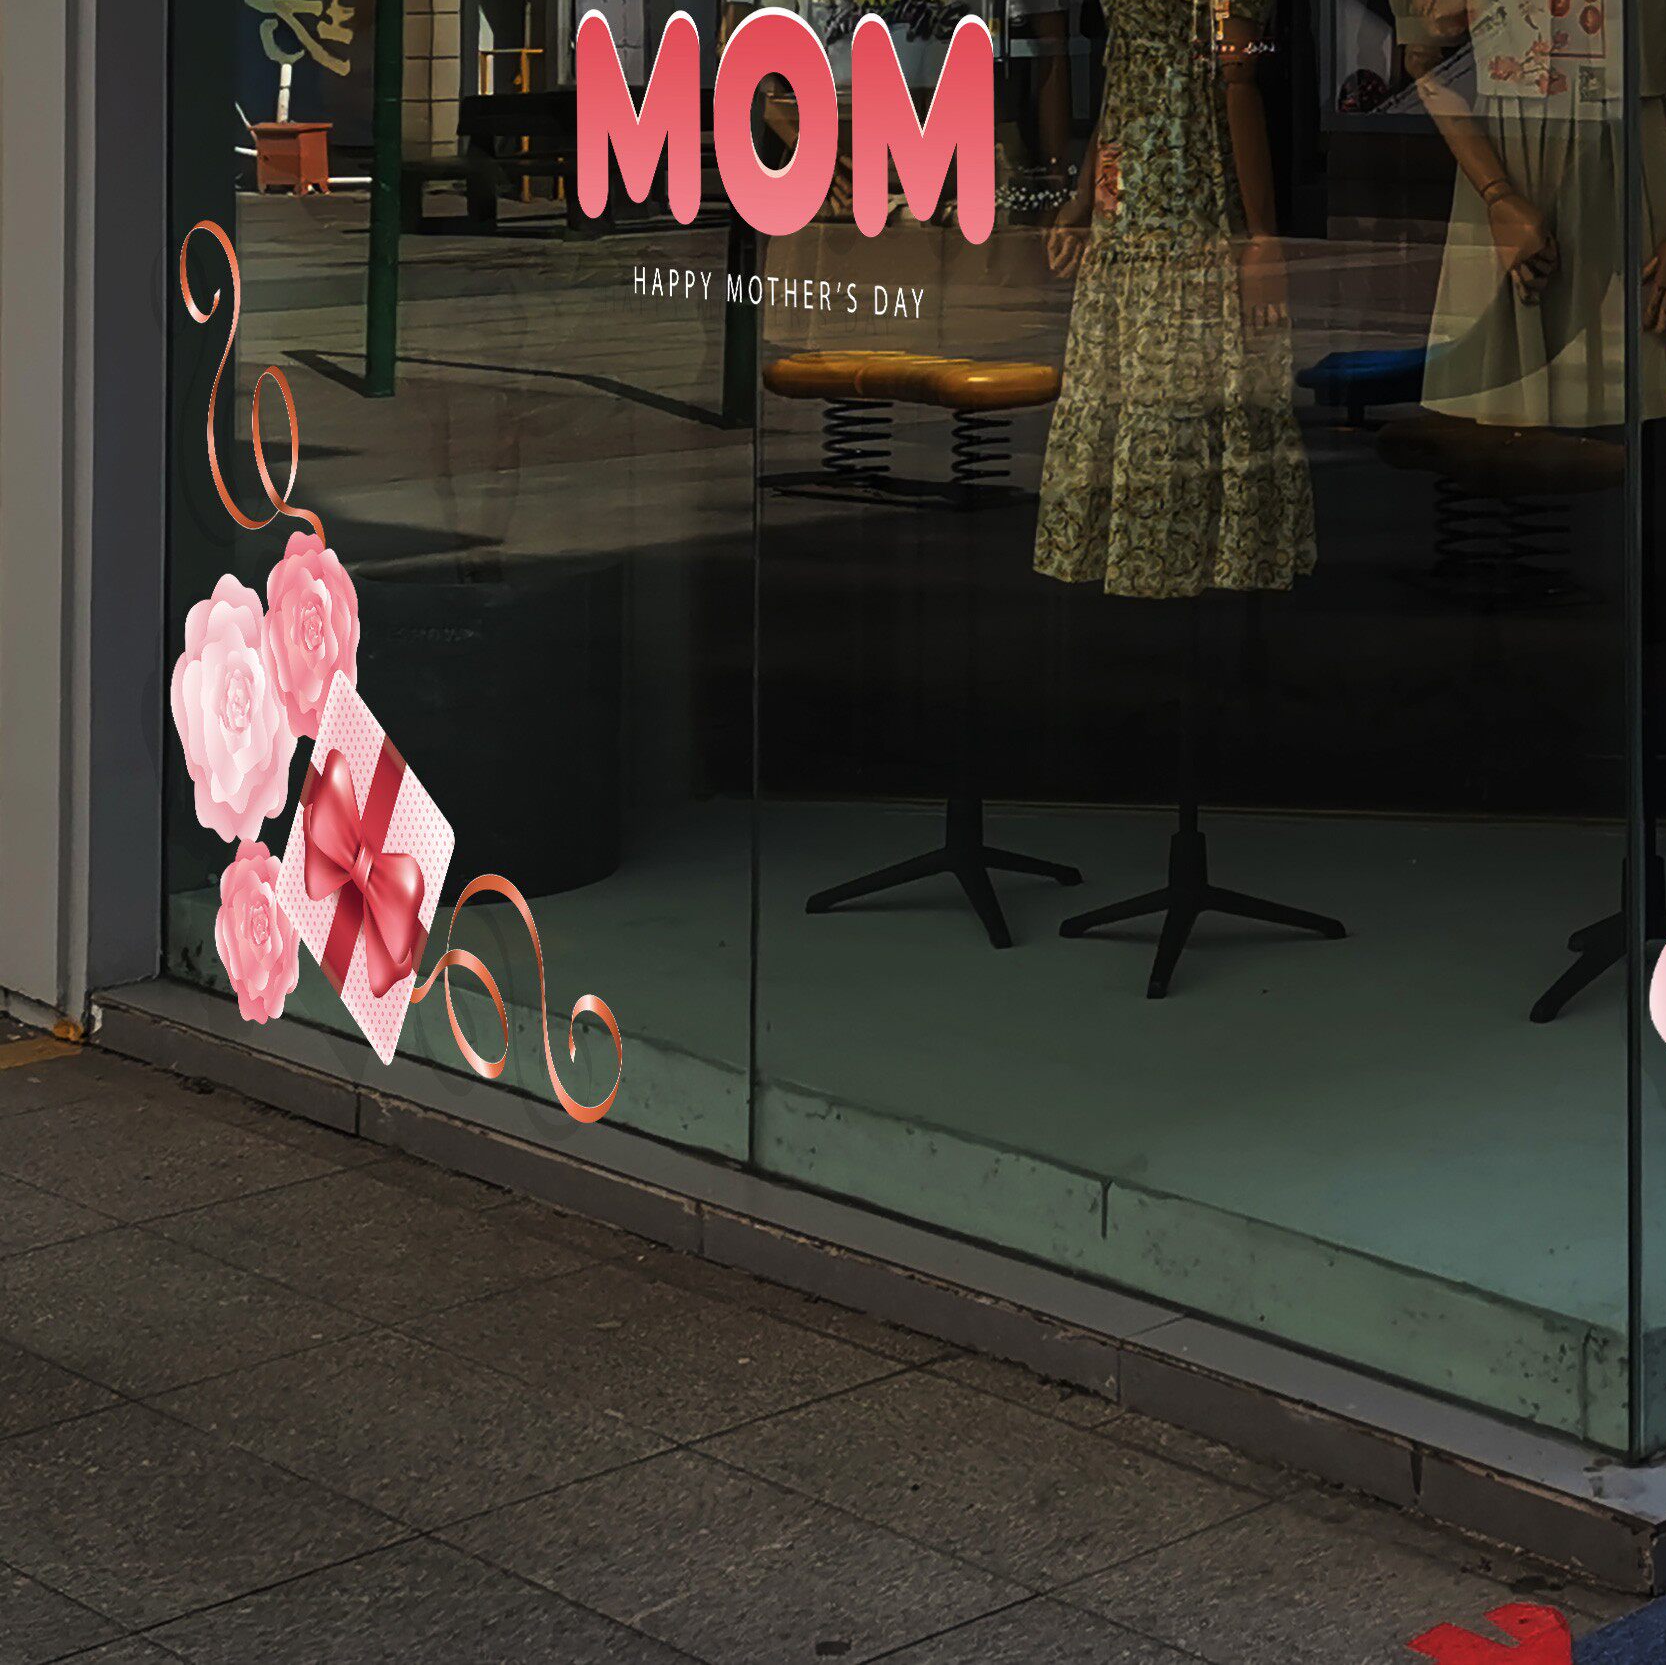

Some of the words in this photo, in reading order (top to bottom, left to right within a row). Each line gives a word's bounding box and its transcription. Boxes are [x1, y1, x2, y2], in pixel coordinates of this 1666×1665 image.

[574, 6, 996, 246] MOM
[633, 266, 713, 301] HAPPY
[726, 273, 858, 315] MOTHER’S
[873, 285, 926, 320] DAY
